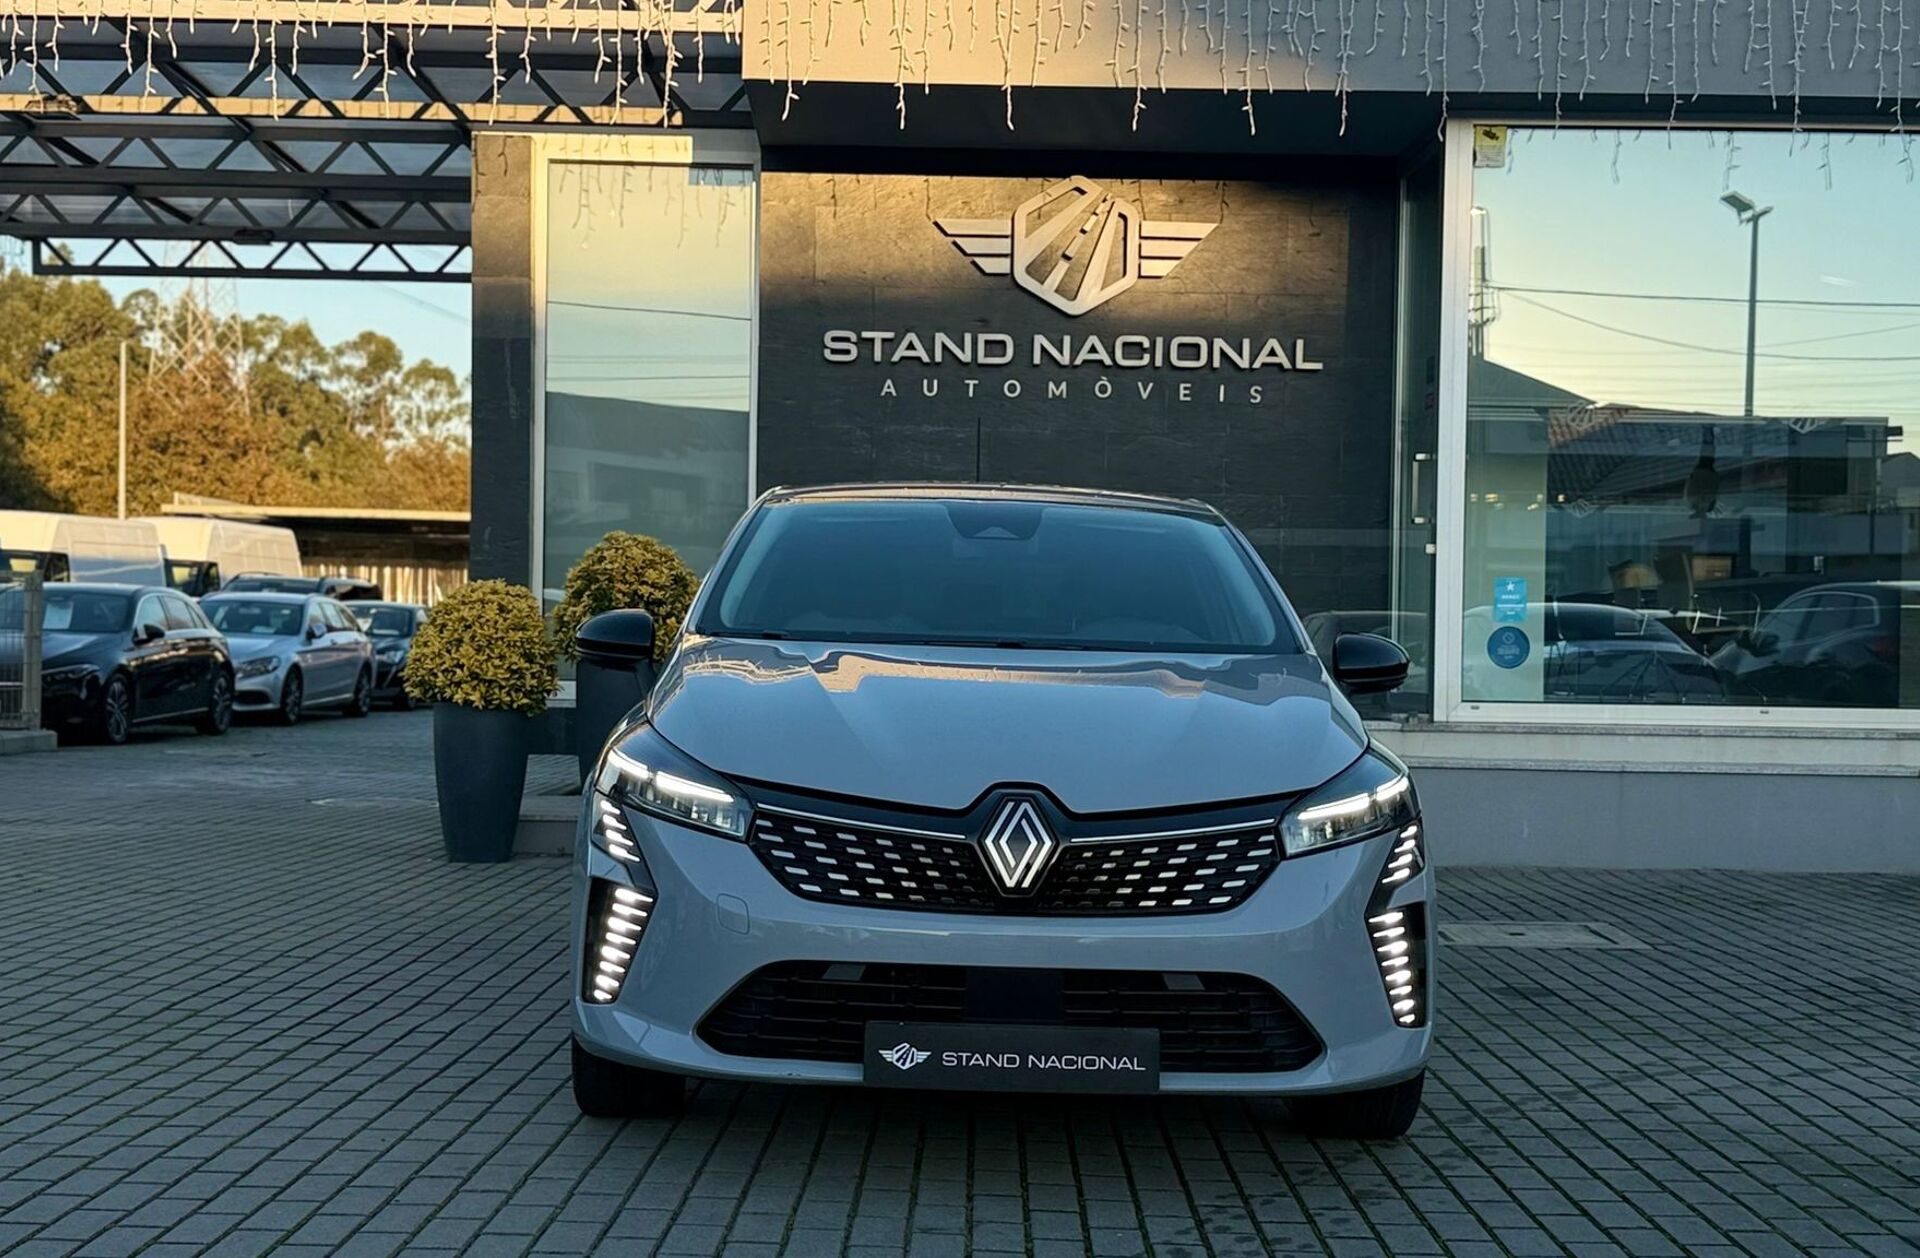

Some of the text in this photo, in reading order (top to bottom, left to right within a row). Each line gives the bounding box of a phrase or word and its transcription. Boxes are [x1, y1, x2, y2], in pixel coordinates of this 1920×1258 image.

[823, 329, 1325, 371] STAND NACIONAL
[941, 1051, 1146, 1071] STAND NACIONAL
